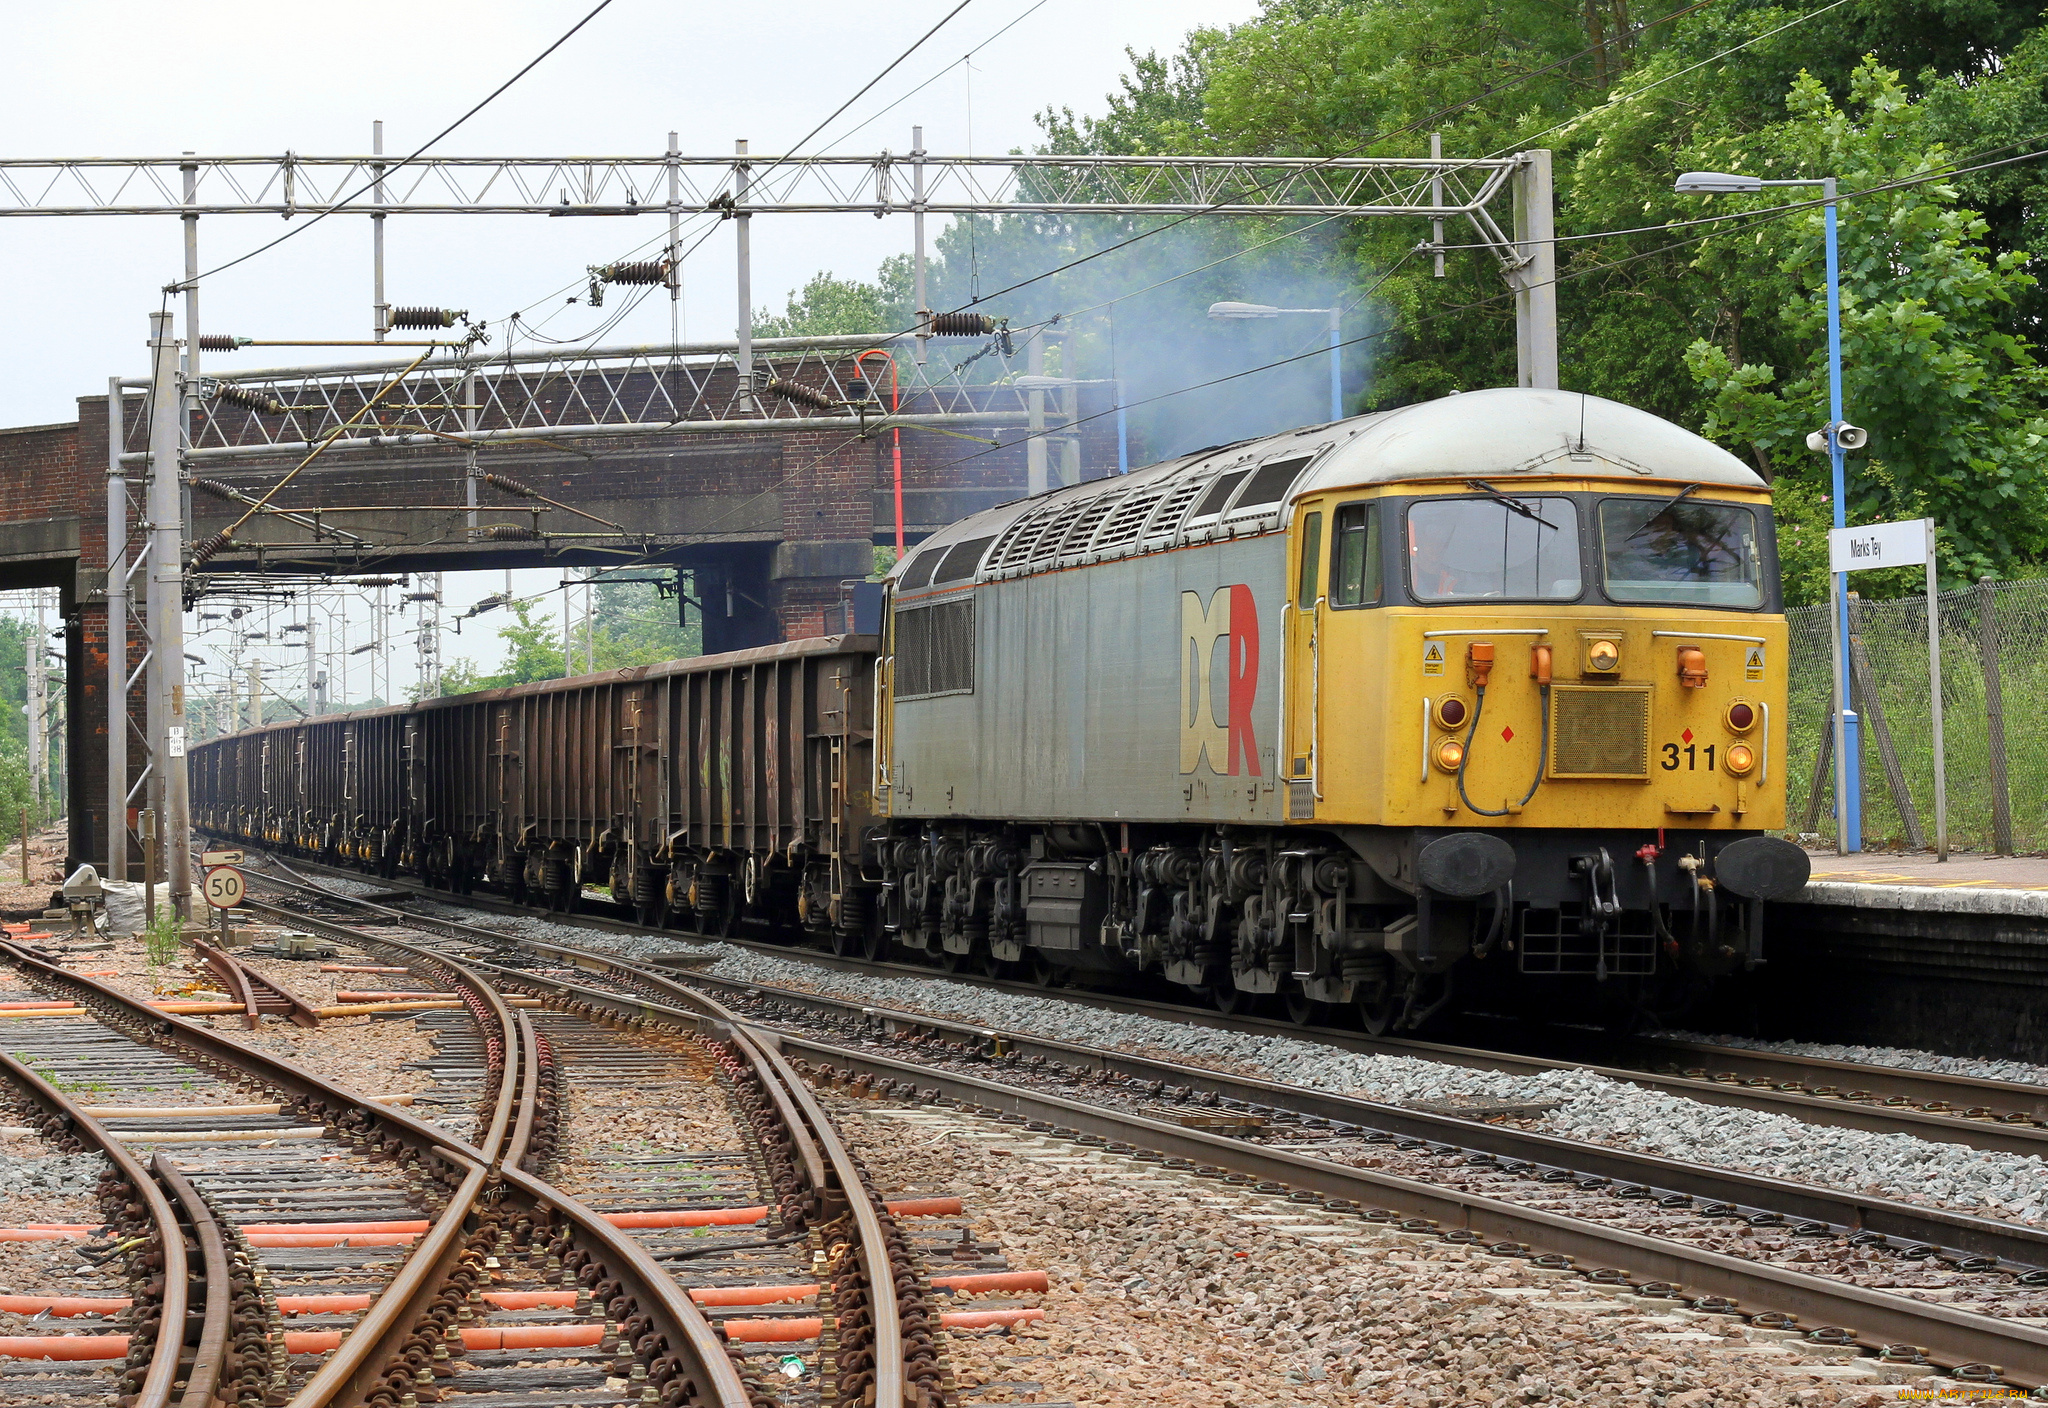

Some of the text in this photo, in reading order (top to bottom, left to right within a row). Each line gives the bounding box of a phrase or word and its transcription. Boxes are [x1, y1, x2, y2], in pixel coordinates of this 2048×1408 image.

[1850, 537, 1882, 560] Marks Tey
[1179, 583, 1262, 777] DCR
[1661, 743, 1715, 771] 311
[211, 877, 238, 897] 50
